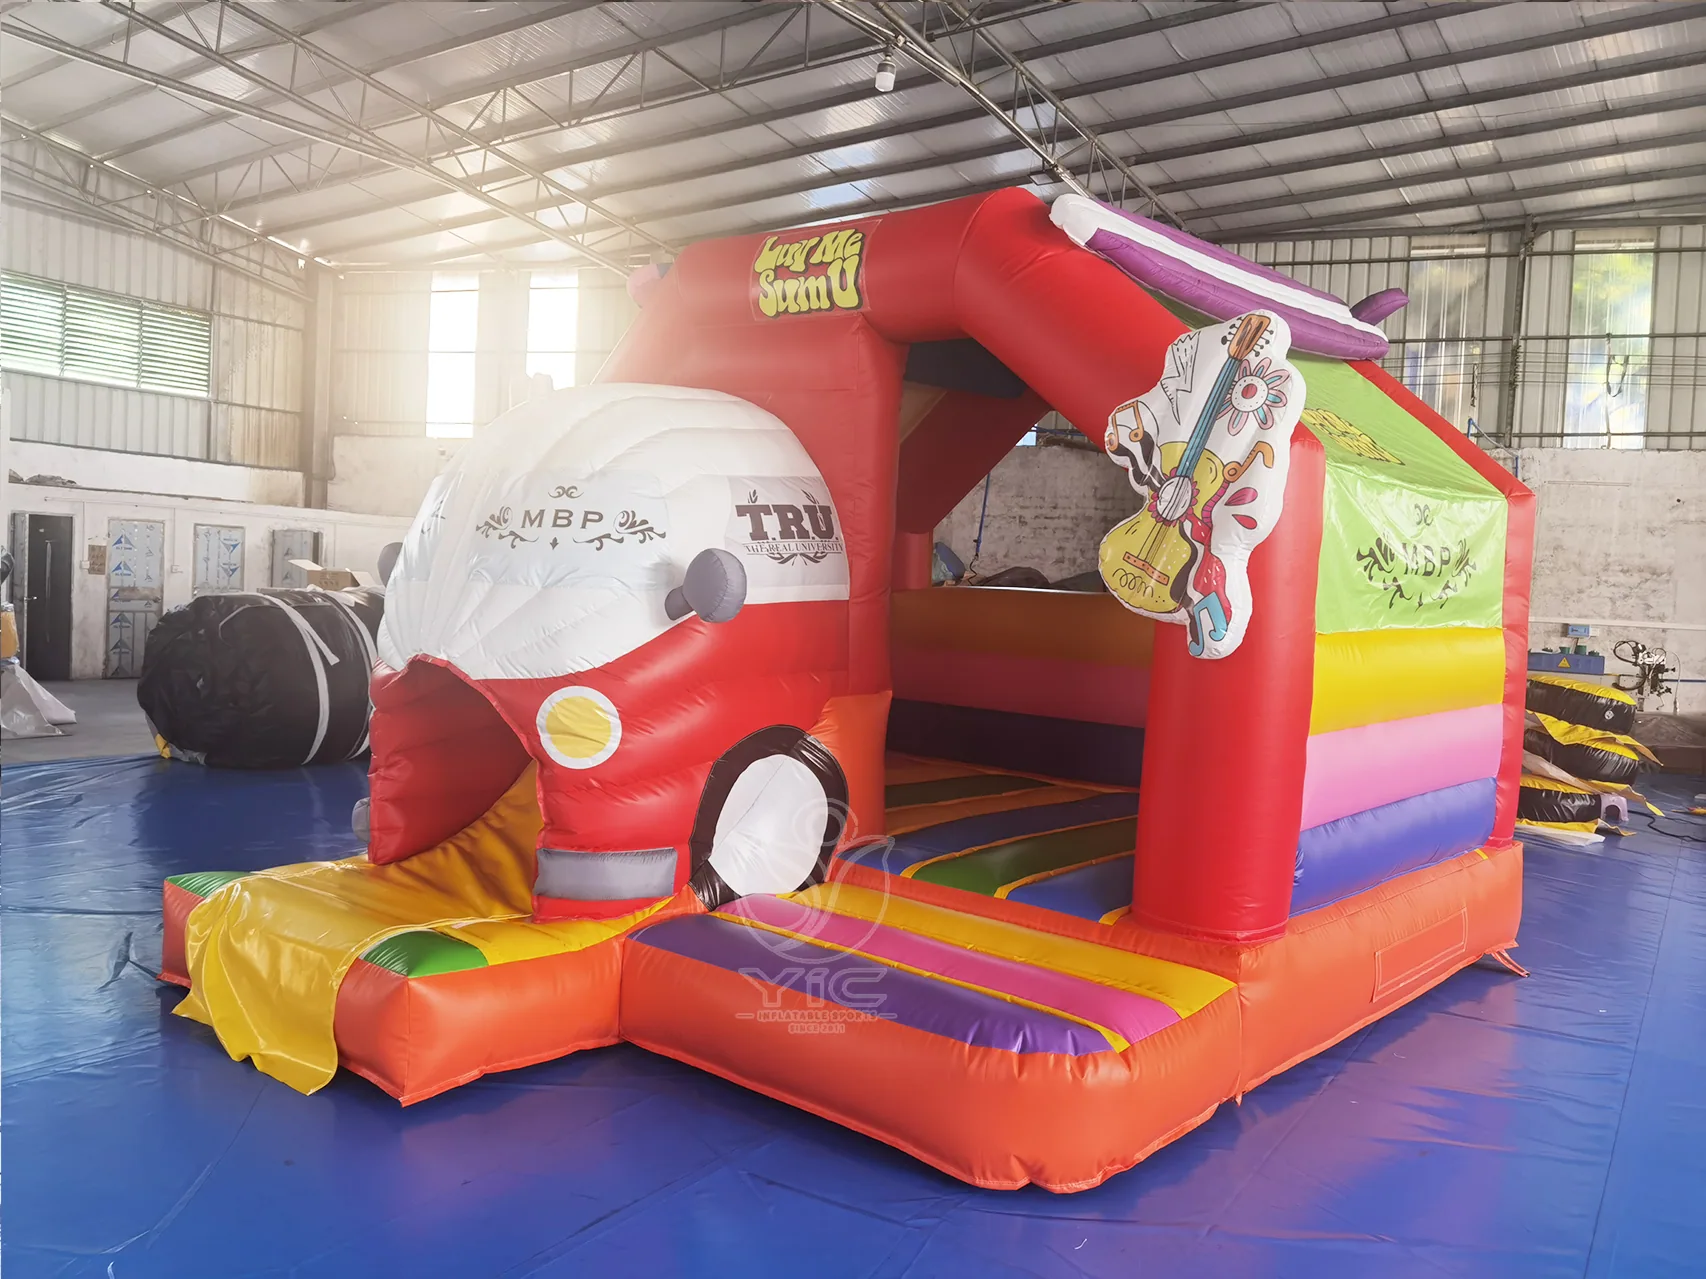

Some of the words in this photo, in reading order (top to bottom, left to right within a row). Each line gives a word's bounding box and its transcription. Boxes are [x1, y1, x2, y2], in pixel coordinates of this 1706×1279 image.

[827, 255, 862, 309] U
[520, 509, 604, 529] MBP
[744, 545, 767, 553] THE
[767, 543, 794, 552] REAL
[795, 542, 843, 552] UNIVERSITY
[1402, 543, 1450, 577] MBP
